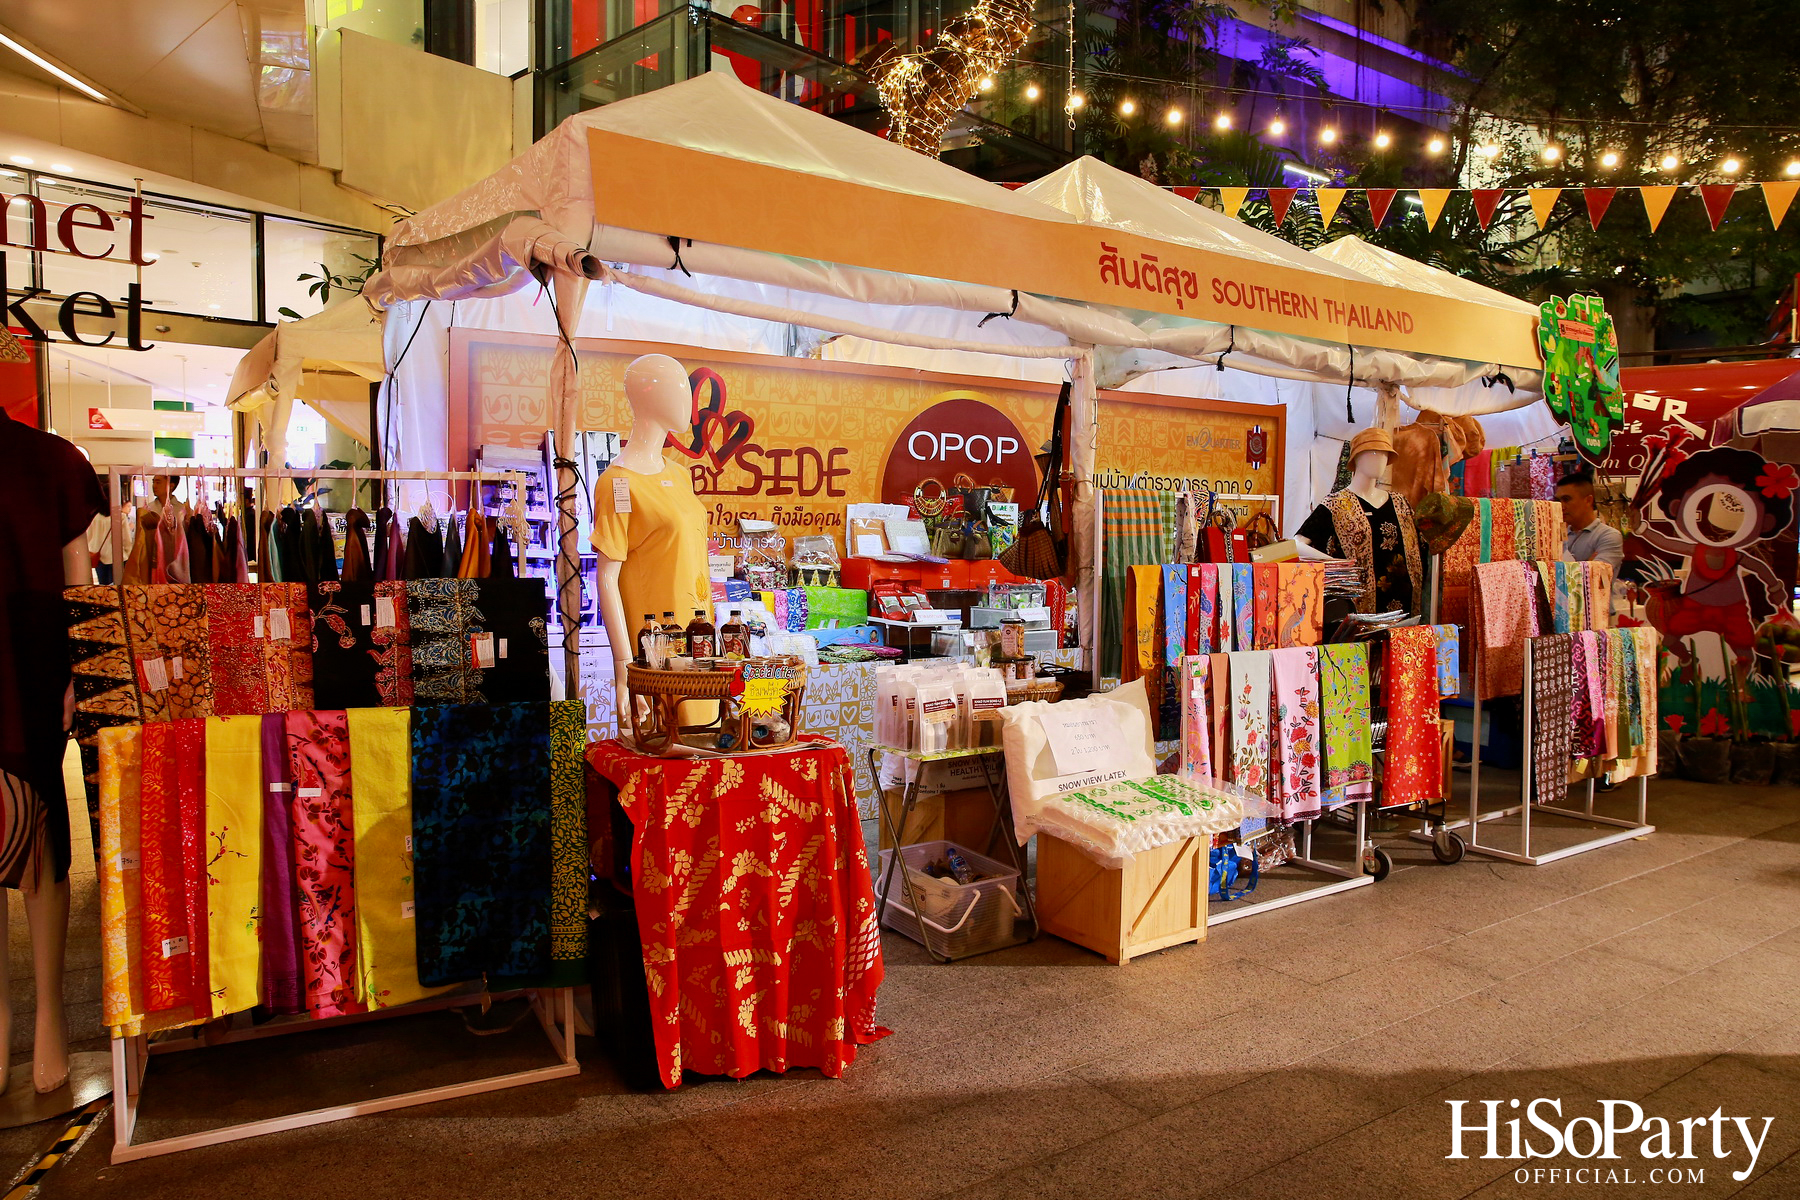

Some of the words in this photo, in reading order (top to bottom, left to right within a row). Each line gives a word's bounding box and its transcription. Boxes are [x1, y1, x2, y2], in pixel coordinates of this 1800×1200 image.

[1099, 241, 1199, 310] สันติสุข
[1211, 277, 1319, 321] SOUTHERN
[1323, 298, 1414, 335] THAILAND
[908, 430, 1019, 465] OPOP
[689, 464, 725, 496] BY
[734, 443, 851, 497] SIDE
[771, 506, 841, 532] ถึงมือคุณ
[743, 664, 775, 682] Special
[775, 665, 795, 680] offer
[947, 758, 970, 769] SNOW
[972, 756, 993, 766] VIW
[1058, 779, 1082, 792] SNOW
[1082, 774, 1104, 786] VIEW
[1103, 769, 1127, 782] LATEX
